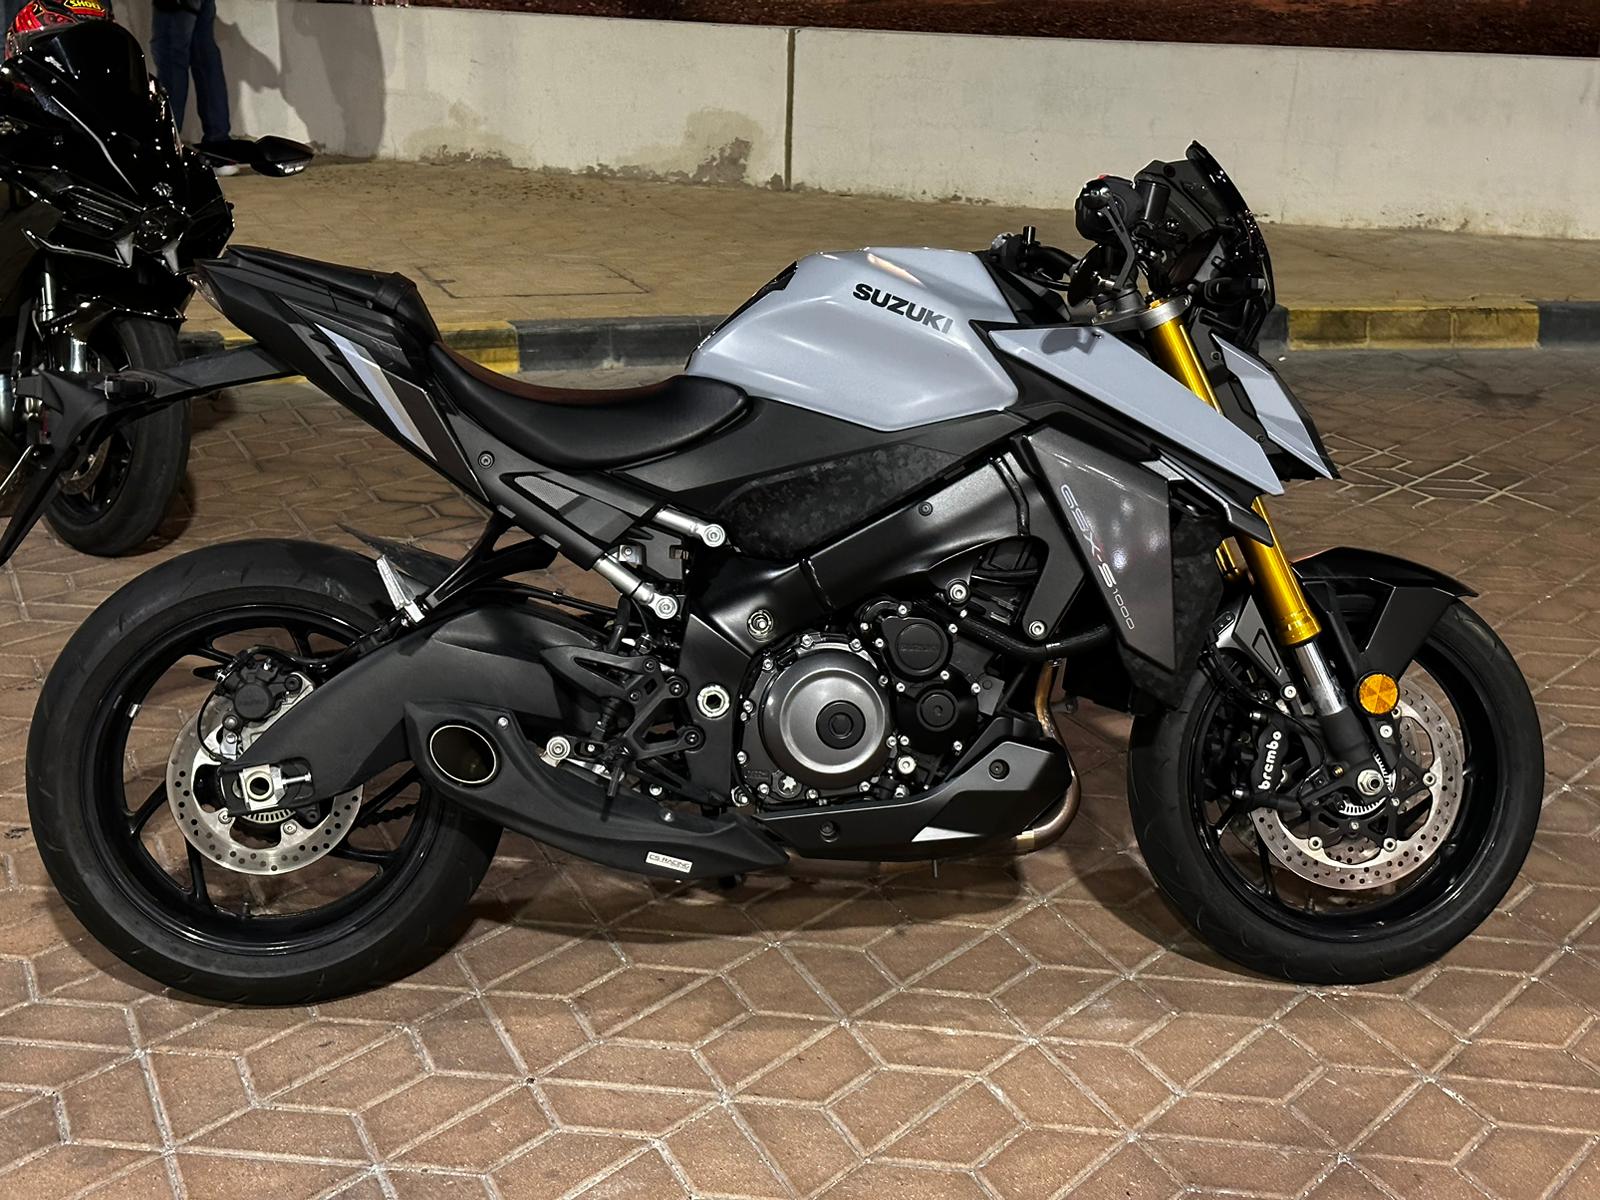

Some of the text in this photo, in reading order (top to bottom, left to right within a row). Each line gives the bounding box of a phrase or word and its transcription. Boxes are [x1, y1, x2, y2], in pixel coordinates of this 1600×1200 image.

[852, 283, 954, 334] SUZUKI
[1060, 484, 1135, 630] GSX-S 1000
[1257, 731, 1282, 790] brembo
